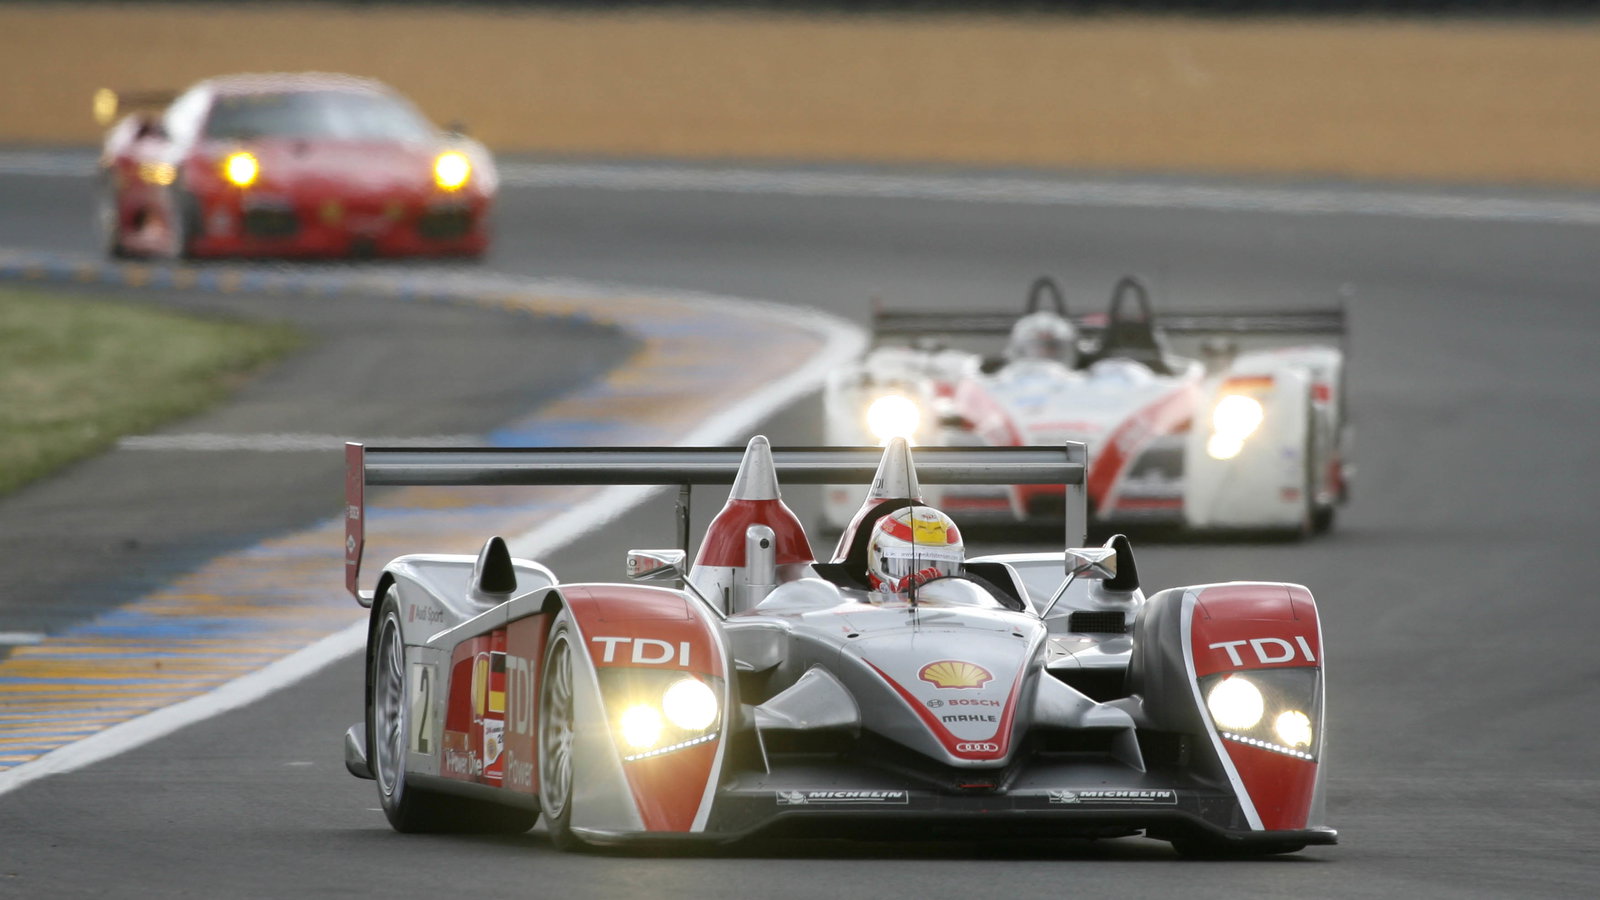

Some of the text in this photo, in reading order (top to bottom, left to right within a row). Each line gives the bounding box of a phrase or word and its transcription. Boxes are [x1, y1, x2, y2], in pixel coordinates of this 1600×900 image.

[415, 604, 444, 625] Audi Sport
[592, 636, 691, 667] TDI
[1208, 635, 1316, 666] TDI
[418, 667, 429, 753] 2
[505, 655, 535, 737] TDI
[948, 699, 1001, 707] BOSCH
[942, 714, 997, 723] MAHLE
[508, 749, 534, 787] Power
